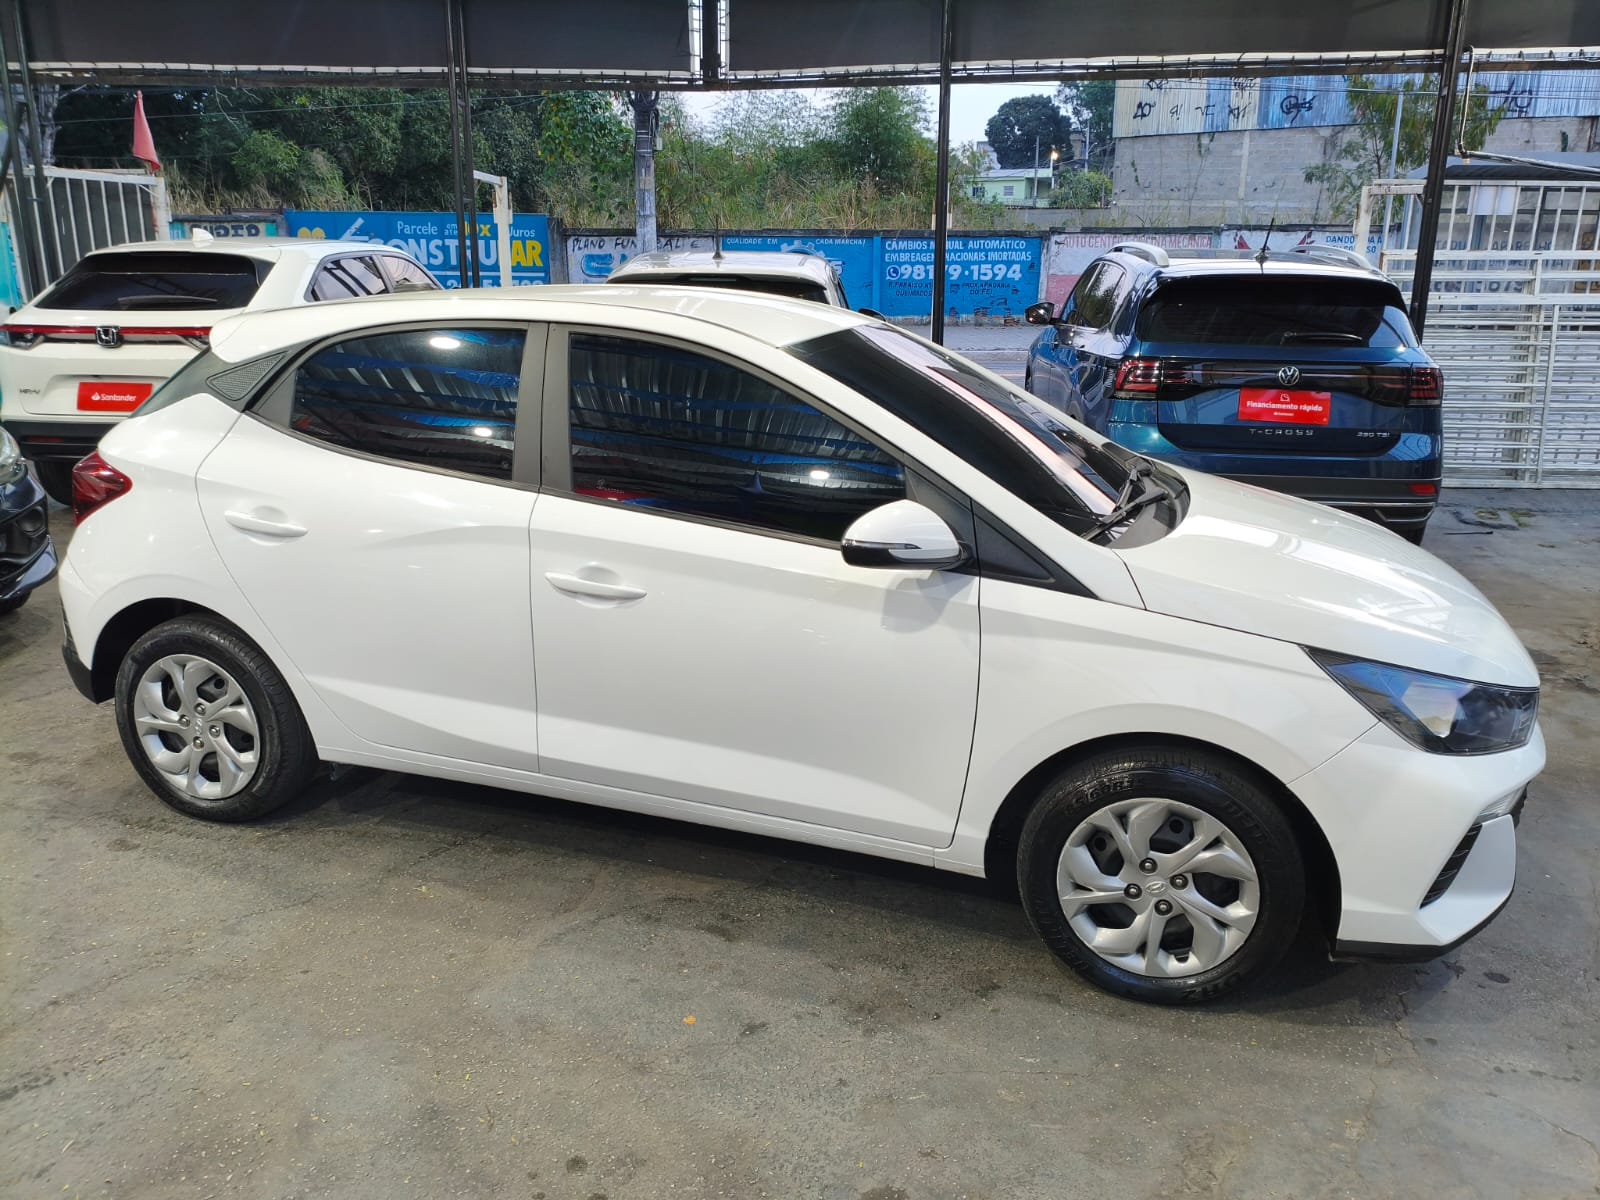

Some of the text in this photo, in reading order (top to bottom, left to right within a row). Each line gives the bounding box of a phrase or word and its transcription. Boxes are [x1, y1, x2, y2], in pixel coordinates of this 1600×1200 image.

[397, 220, 438, 235] Parcele
[572, 236, 606, 252] PLANO
[930, 240, 964, 250] MUAL
[968, 237, 1026, 250] AUTOMÁTICO
[1325, 235, 1355, 244] DANDO
[987, 251, 1032, 262] IMORTADAS
[100, 394, 137, 402] Santander
[1246, 400, 1323, 413] Financiamento rápido
[1249, 428, 1314, 436] T-CROSS
